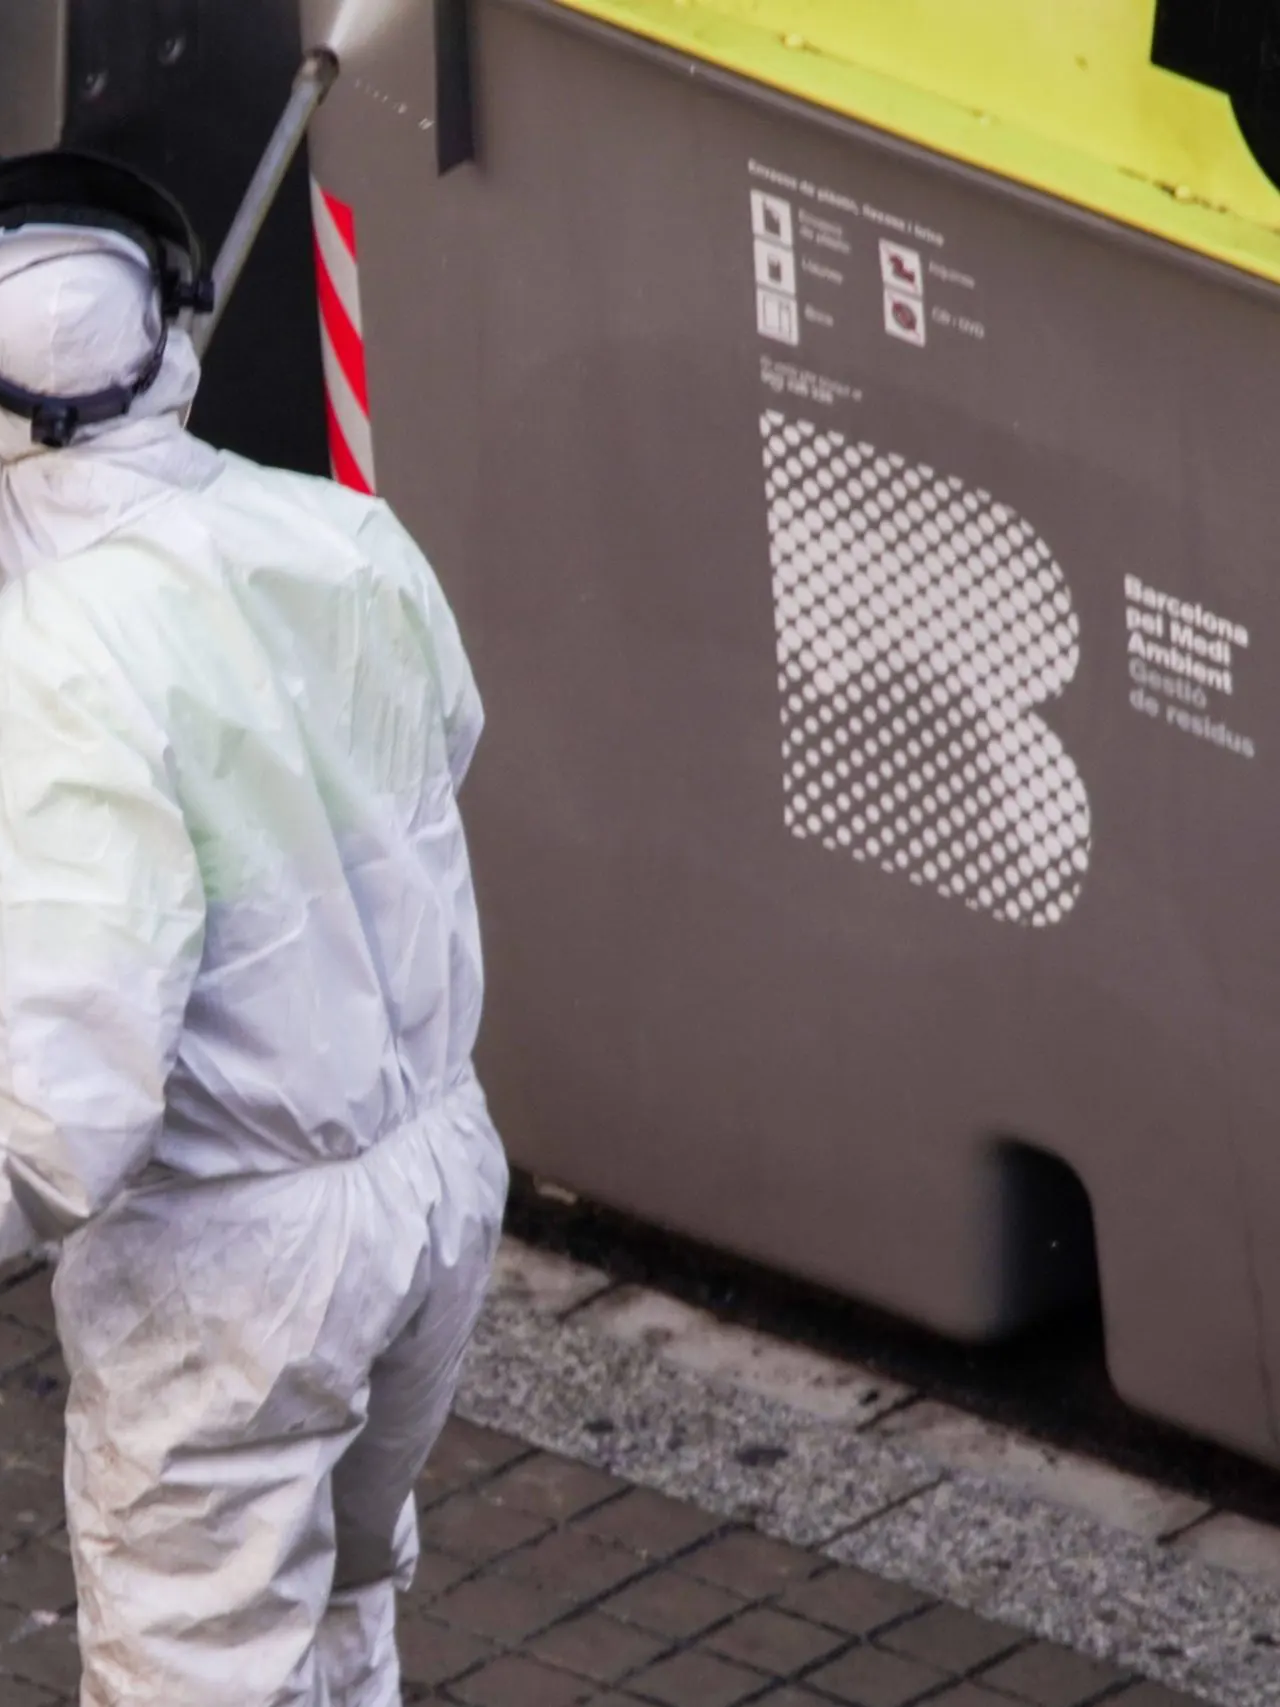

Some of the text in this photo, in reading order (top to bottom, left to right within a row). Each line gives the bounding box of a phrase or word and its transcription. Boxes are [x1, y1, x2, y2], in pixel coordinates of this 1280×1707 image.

[799, 180, 816, 198] de
[1124, 573, 1249, 648] Barcelona
[1127, 630, 1233, 696] Ambient
[1170, 618, 1232, 668] Medi
[1129, 657, 1208, 711] Gestió
[1129, 687, 1256, 759] de residus
